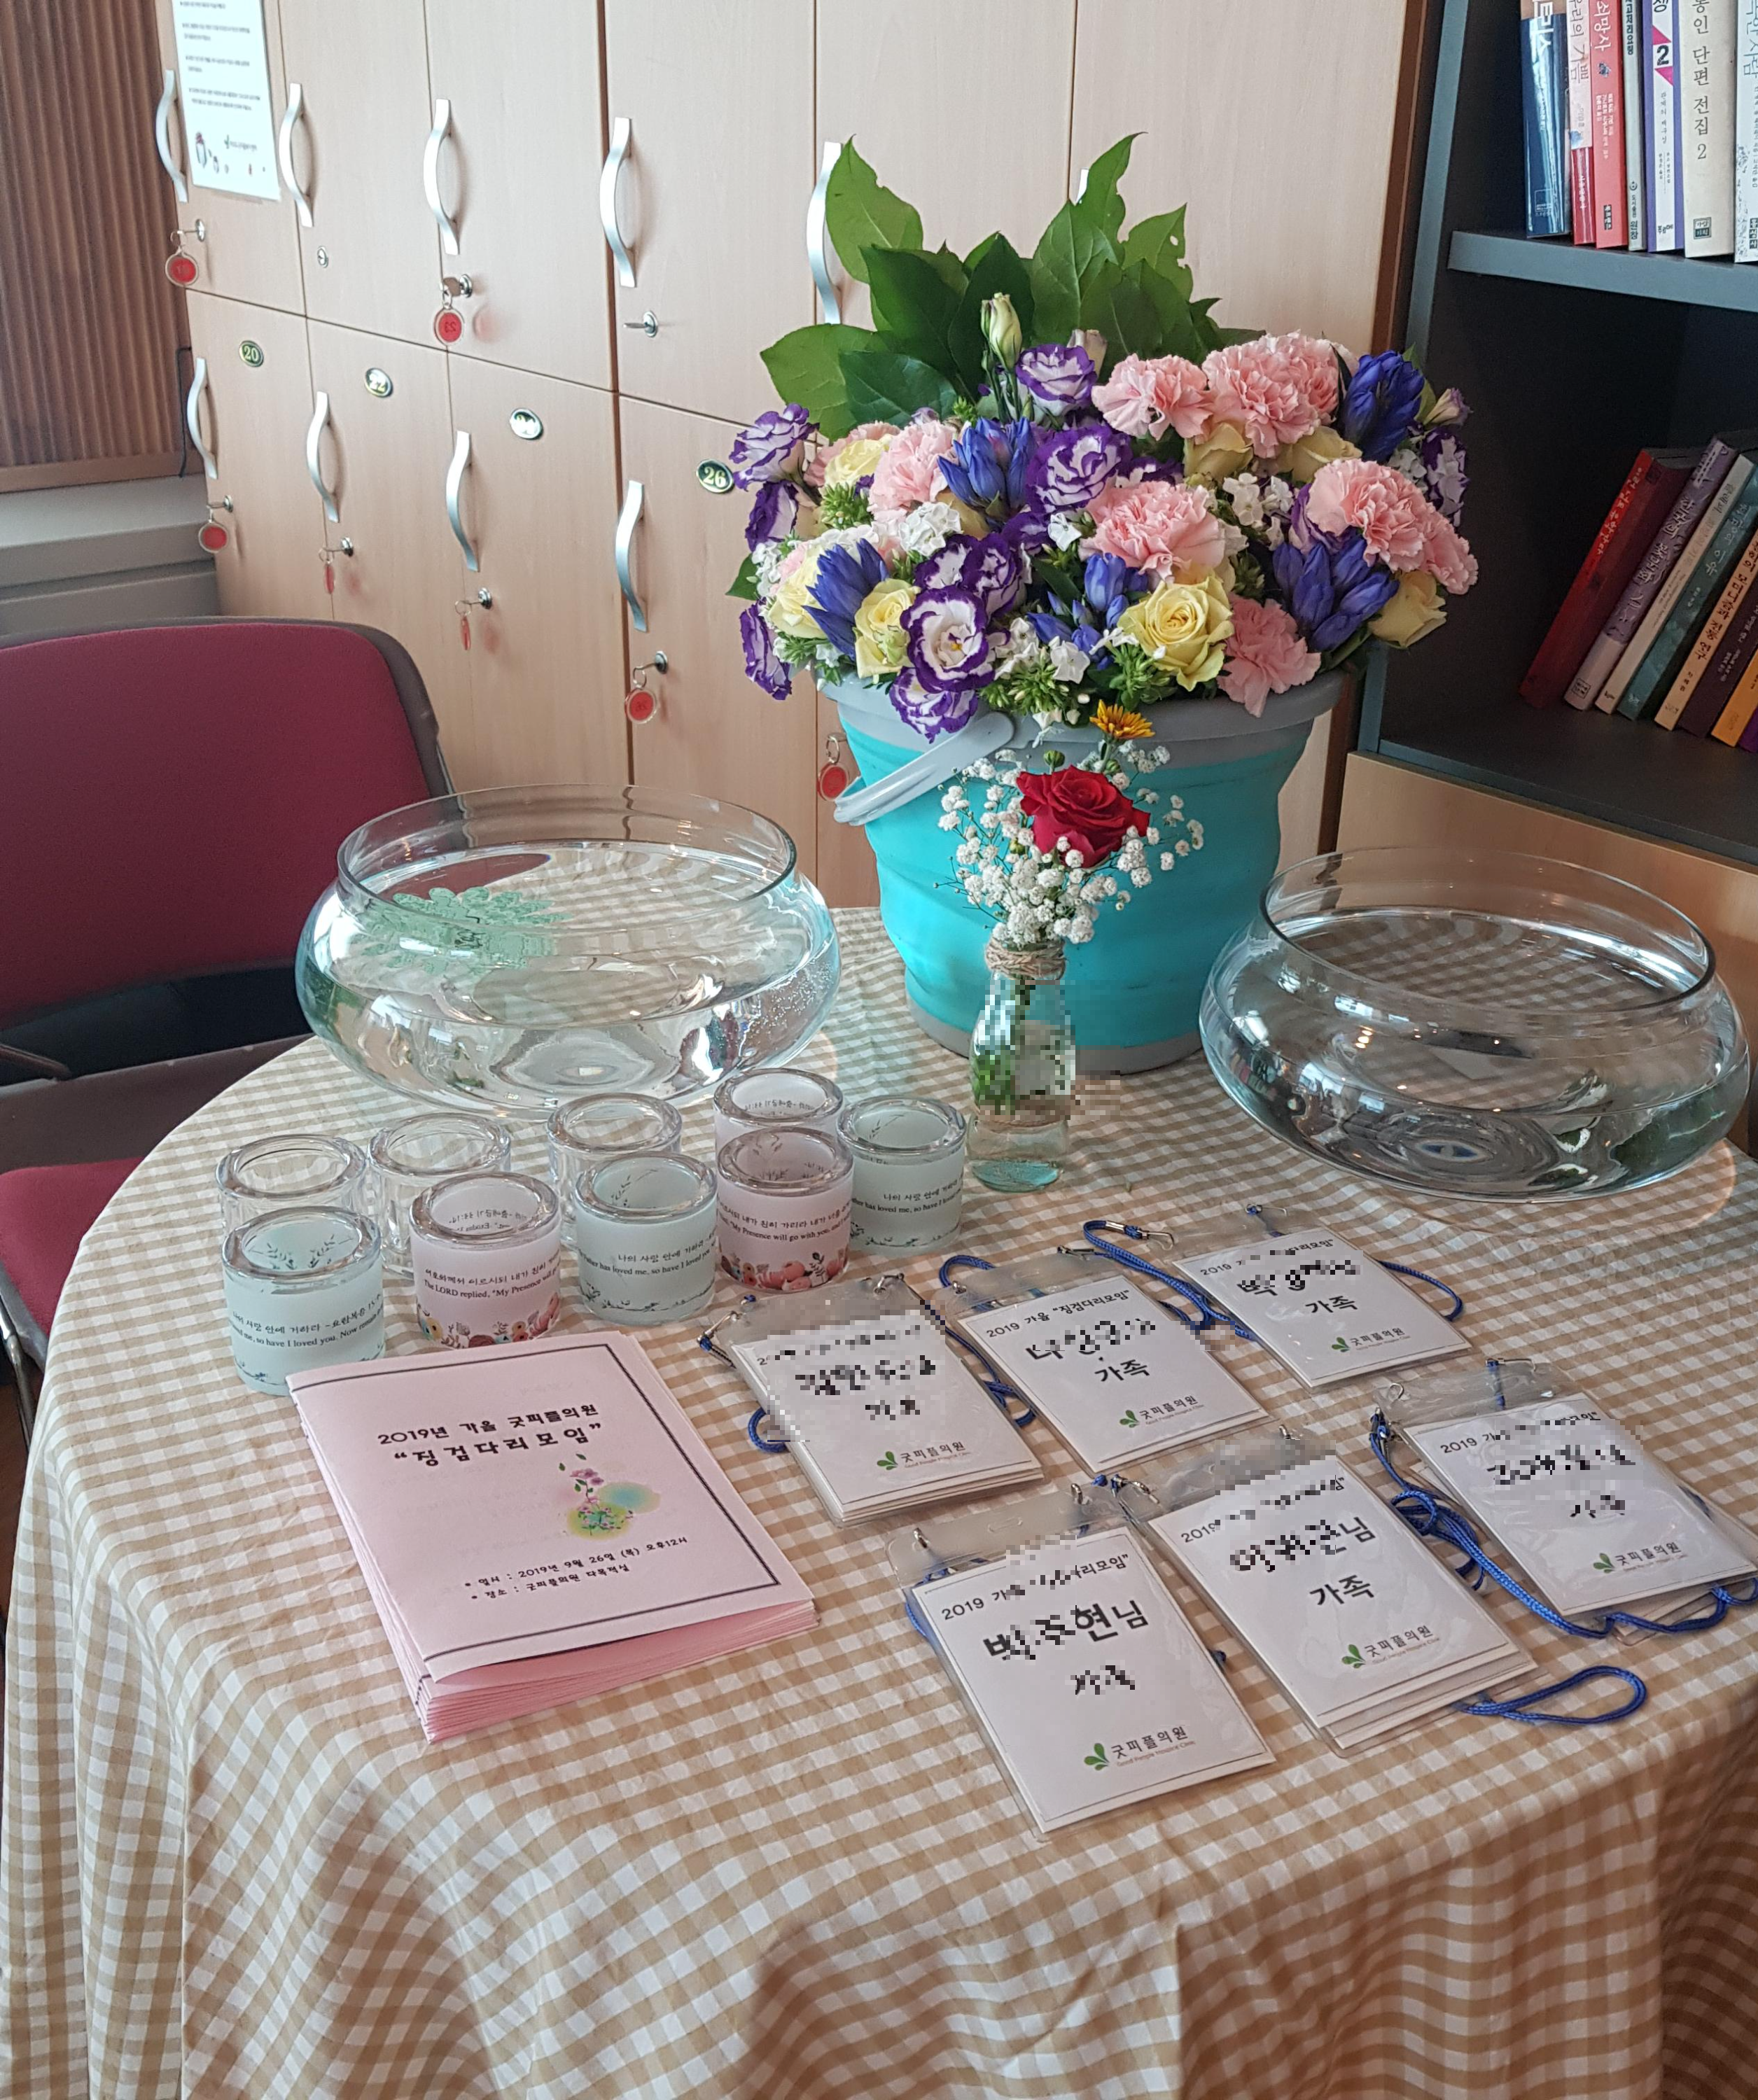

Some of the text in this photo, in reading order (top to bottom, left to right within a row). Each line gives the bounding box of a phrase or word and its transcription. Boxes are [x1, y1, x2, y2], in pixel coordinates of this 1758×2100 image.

[1571, 43, 1589, 83] 기쁨
[1656, 45, 1669, 66] 2
[1692, 46, 1710, 85] 단편
[1694, 96, 1710, 135] 전집
[1698, 144, 1707, 160] 2
[244, 344, 259, 362] 20
[704, 465, 726, 489] 26
[865, 1201, 876, 1210] has
[877, 1205, 897, 1213] loved
[922, 1203, 937, 1211] have
[742, 1216, 758, 1226] 내가
[781, 1220, 807, 1228] 가리라
[810, 1217, 825, 1226] 내가
[742, 1227, 771, 1240] Presence
[801, 1231, 815, 1240] with
[662, 1250, 681, 1261] 안에
[425, 1268, 465, 1284] 여호와께서
[468, 1275, 507, 1286] 이르시되
[511, 1270, 528, 1280] 내가
[599, 1261, 611, 1271] has
[613, 1265, 632, 1275] loved
[662, 1264, 679, 1273] have
[1200, 1264, 1232, 1276] 2019
[424, 1280, 434, 1290] The
[435, 1284, 458, 1296] LORD
[460, 1289, 490, 1298] replied,
[512, 1279, 541, 1294] Presence
[1305, 1295, 1359, 1314] 가족
[265, 1325, 285, 1334] 안에
[290, 1324, 319, 1334] 거하라
[986, 1322, 1020, 1338] 2019
[1024, 1312, 1050, 1324] 가을
[266, 1338, 285, 1347] have
[293, 1337, 317, 1347] loved
[340, 1327, 357, 1339] Now
[1349, 1327, 1406, 1346] 굿피플의원
[1094, 1359, 1151, 1383] 가족
[1139, 1395, 1198, 1420] 굿피플의원
[377, 1404, 599, 1445] 2019년 가을 굿피플의원
[900, 1441, 966, 1463] 굿피플의원
[1440, 1437, 1478, 1454] 2019
[1181, 1522, 1218, 1543] 2019
[518, 1564, 559, 1578] 2019년
[564, 1558, 584, 1568] 9월
[589, 1552, 615, 1564] 26일
[620, 1547, 640, 1558] (목)
[1614, 1541, 1682, 1566] 굿피플의원
[484, 1588, 508, 1599] 장소
[585, 1563, 630, 1577] 다목적실
[1309, 1574, 1376, 1606] 가족
[942, 1597, 984, 1620] 2019
[1365, 1625, 1433, 1658] 굿피플의원
[1110, 1726, 1188, 1759] 굿피플의원
